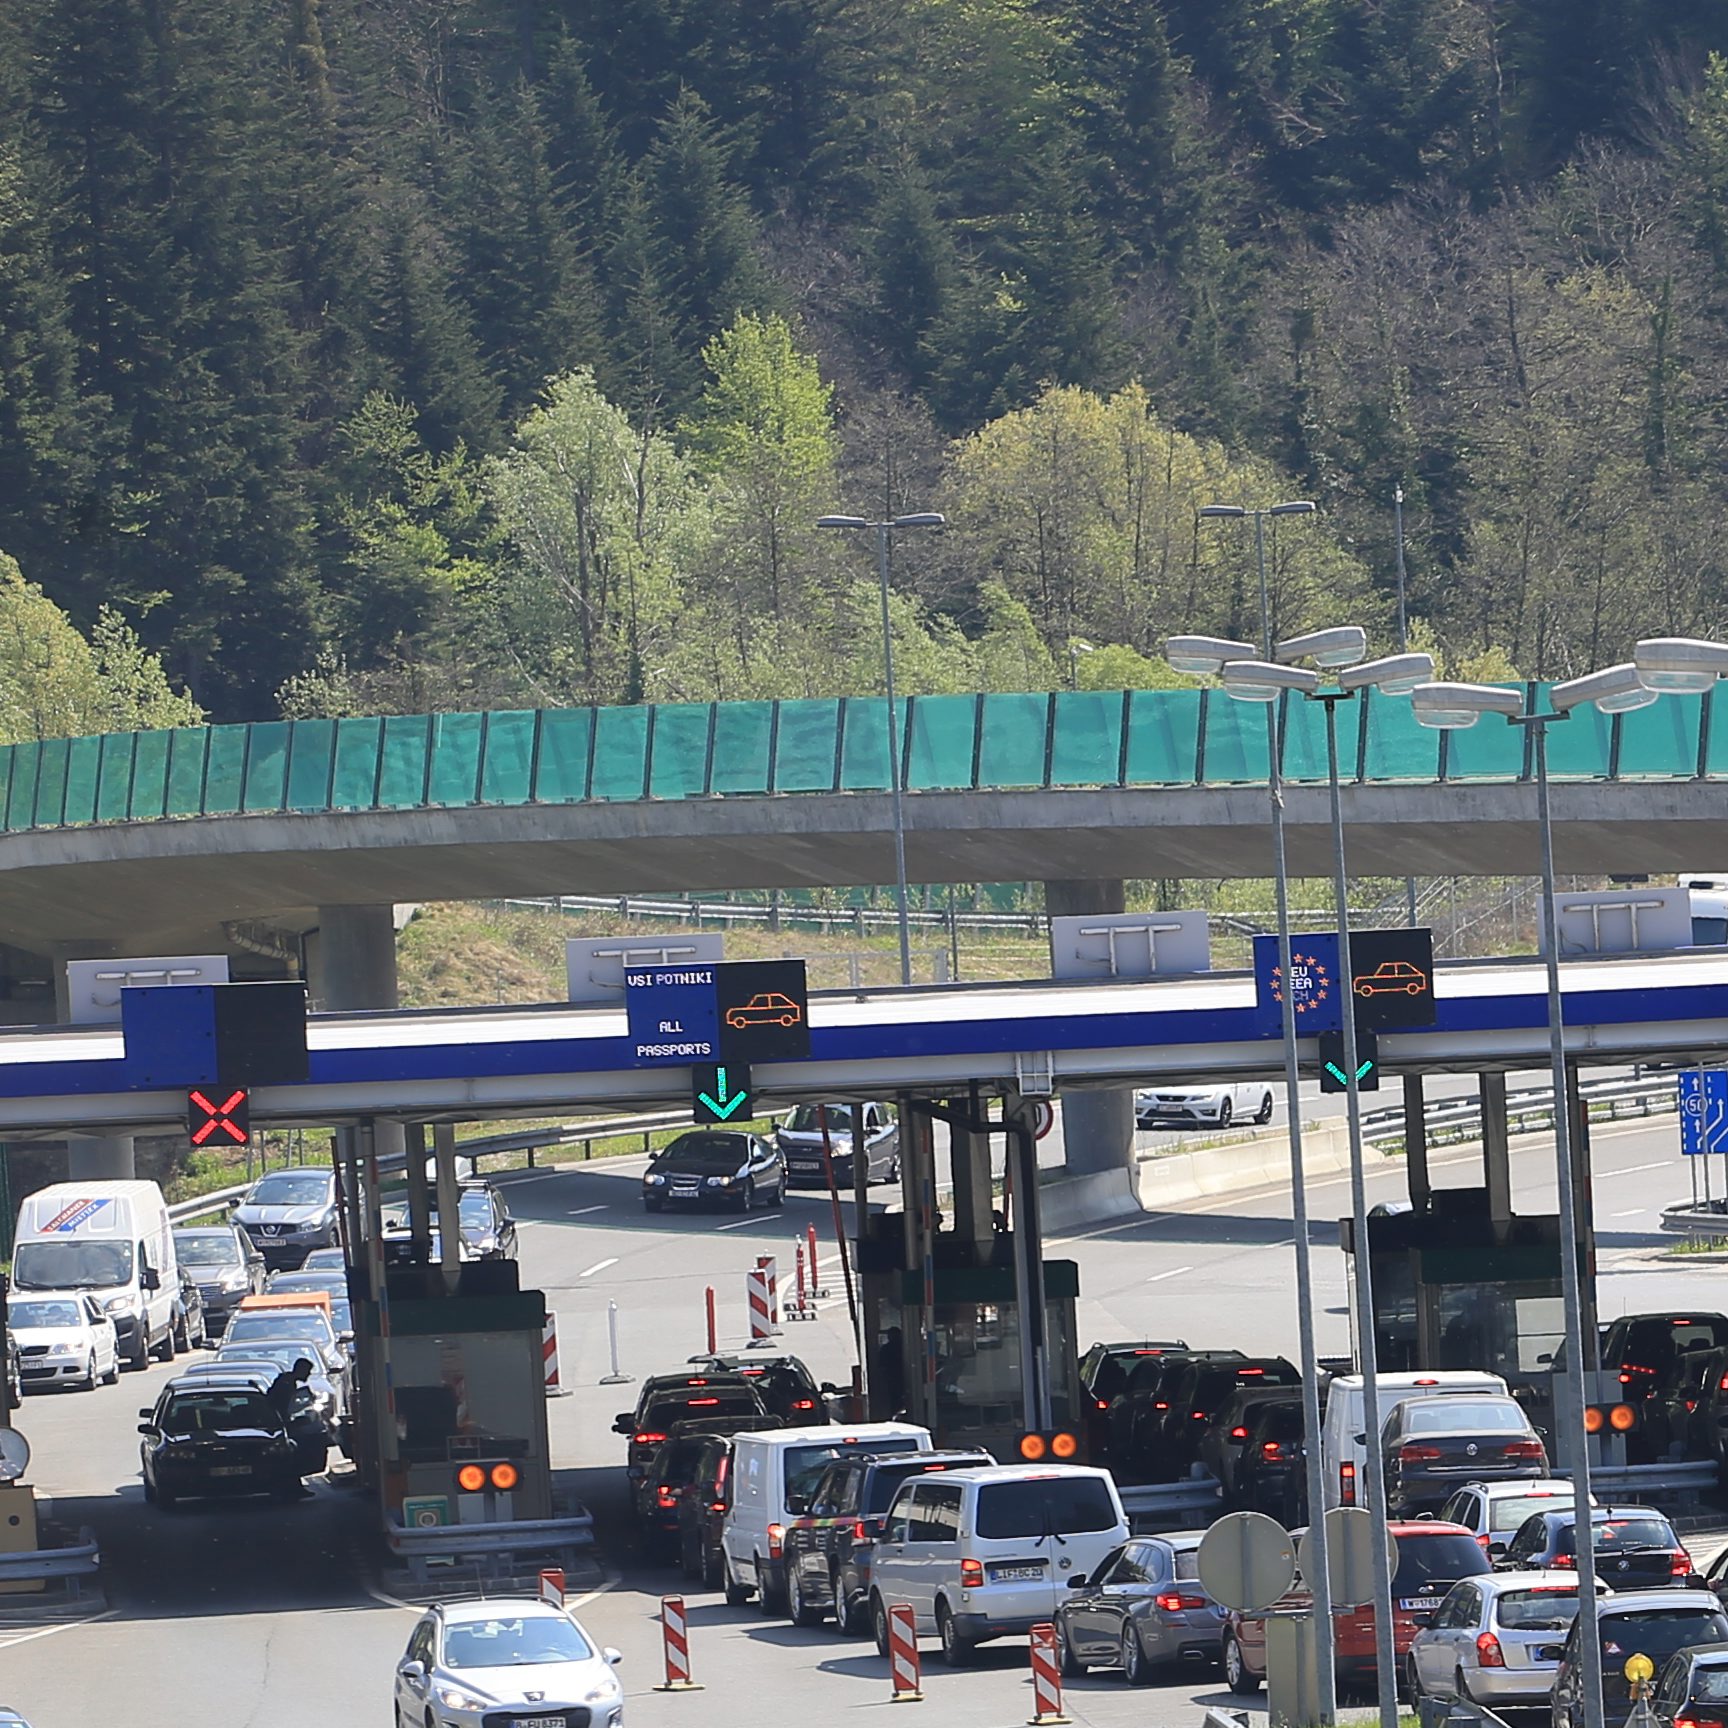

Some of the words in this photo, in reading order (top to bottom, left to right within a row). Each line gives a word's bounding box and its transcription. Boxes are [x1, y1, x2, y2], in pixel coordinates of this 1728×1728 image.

[627, 974, 653, 987] VSI
[656, 971, 712, 986] POTNIKI
[1291, 966, 1308, 978] EU
[659, 1019, 684, 1033] ALL
[636, 1042, 711, 1057] PASSPORTS
